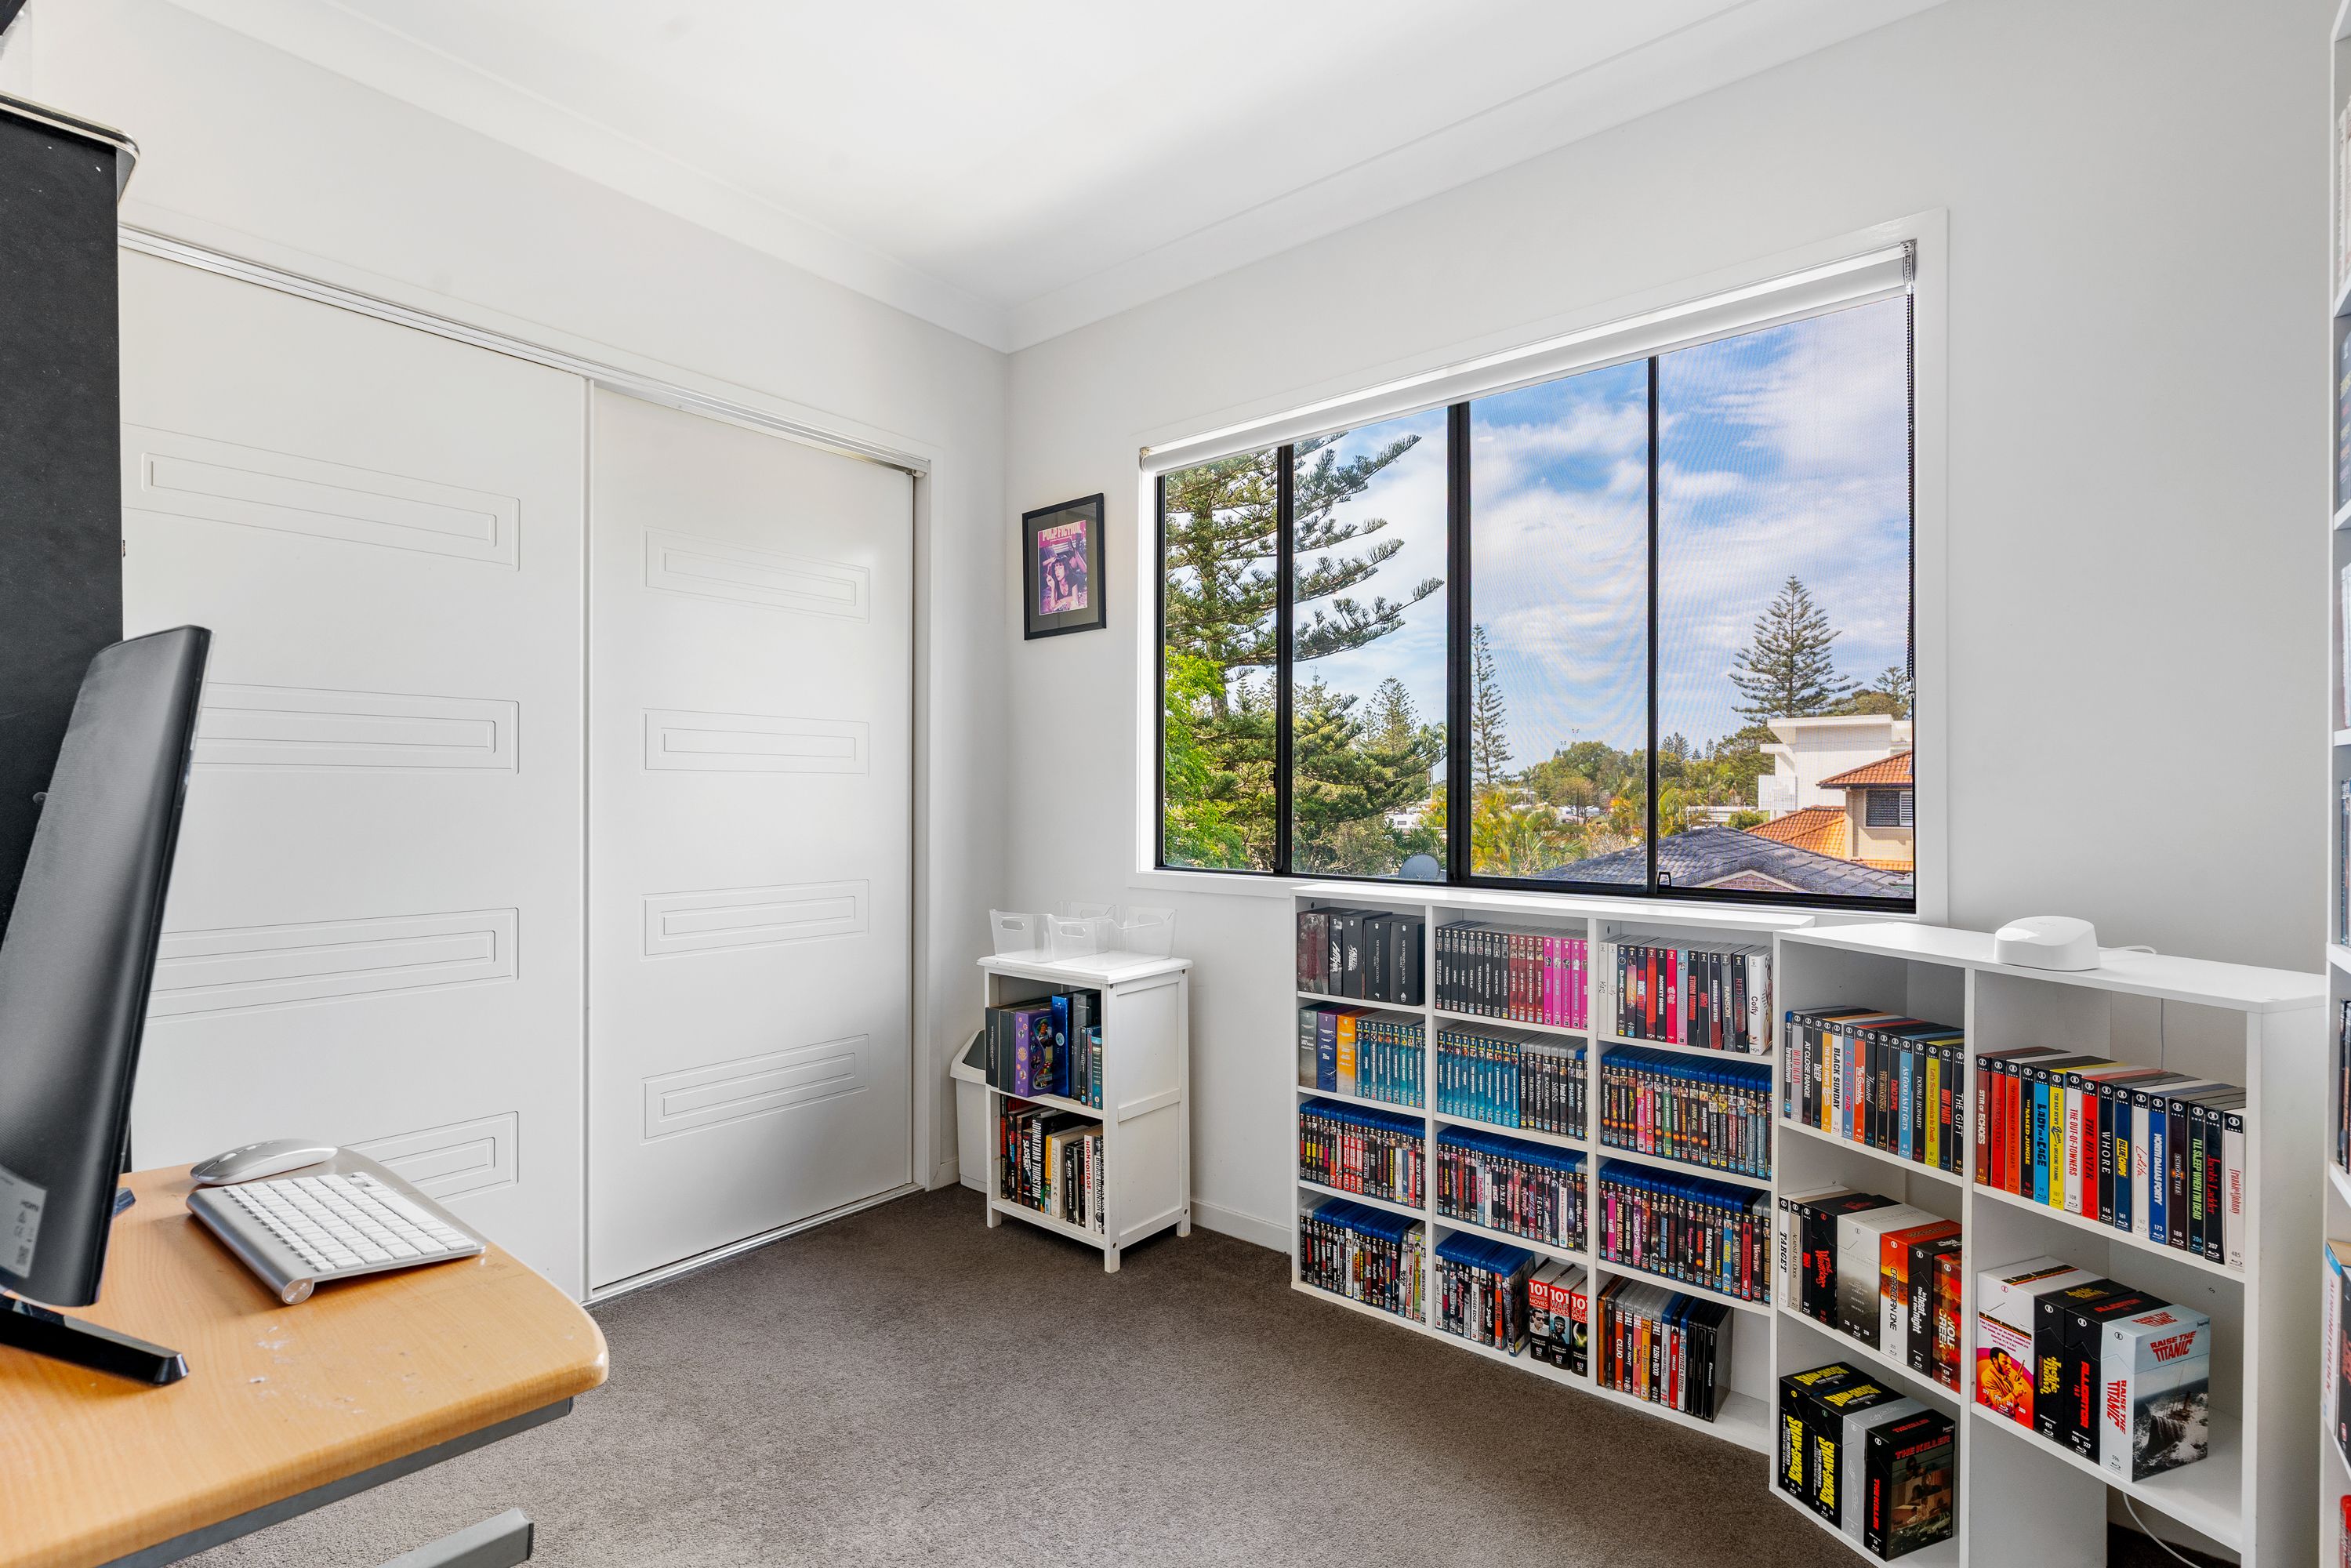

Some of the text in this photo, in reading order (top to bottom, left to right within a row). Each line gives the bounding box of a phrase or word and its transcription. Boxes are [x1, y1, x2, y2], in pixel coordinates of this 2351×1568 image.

[1750, 996, 1758, 1015] Coffy
[1805, 1041, 1810, 1050] AT
[1978, 1113, 1986, 1145] ECHOES
[2069, 1109, 2078, 1176] THE OUT-OF-TOWNERS
[2101, 1131, 2111, 1174] WHORE
[1032, 1120, 1042, 1199] JOHNATHAN THURSTON
[2118, 1140, 2127, 1177] BLUE CHIPS
[2135, 1145, 2147, 1179] Lolita
[2193, 1171, 2202, 1192] WHEN
[2193, 1203, 2201, 1220] DEAD
[2207, 1185, 2220, 1214] Ladder
[1529, 1282, 1548, 1297] 101
[1551, 1289, 1569, 1304] 101
[1530, 1298, 1548, 1307] MOVIES
[1572, 1295, 1587, 1311] 10
[1917, 1296, 1927, 1316] heat
[1910, 1312, 1922, 1334] night
[2150, 1330, 2197, 1349] RAISE THE
[2153, 1339, 2193, 1362] TITANIC
[2080, 1360, 2090, 1429] ALLIGATOR
[2106, 1381, 2120, 1428] TITANIC
[1787, 1414, 1803, 1486] SHAW-SHOCK
[1896, 1435, 1950, 1460] THE KILLER
[1818, 1436, 1834, 1509] SHAW-SHOCK
